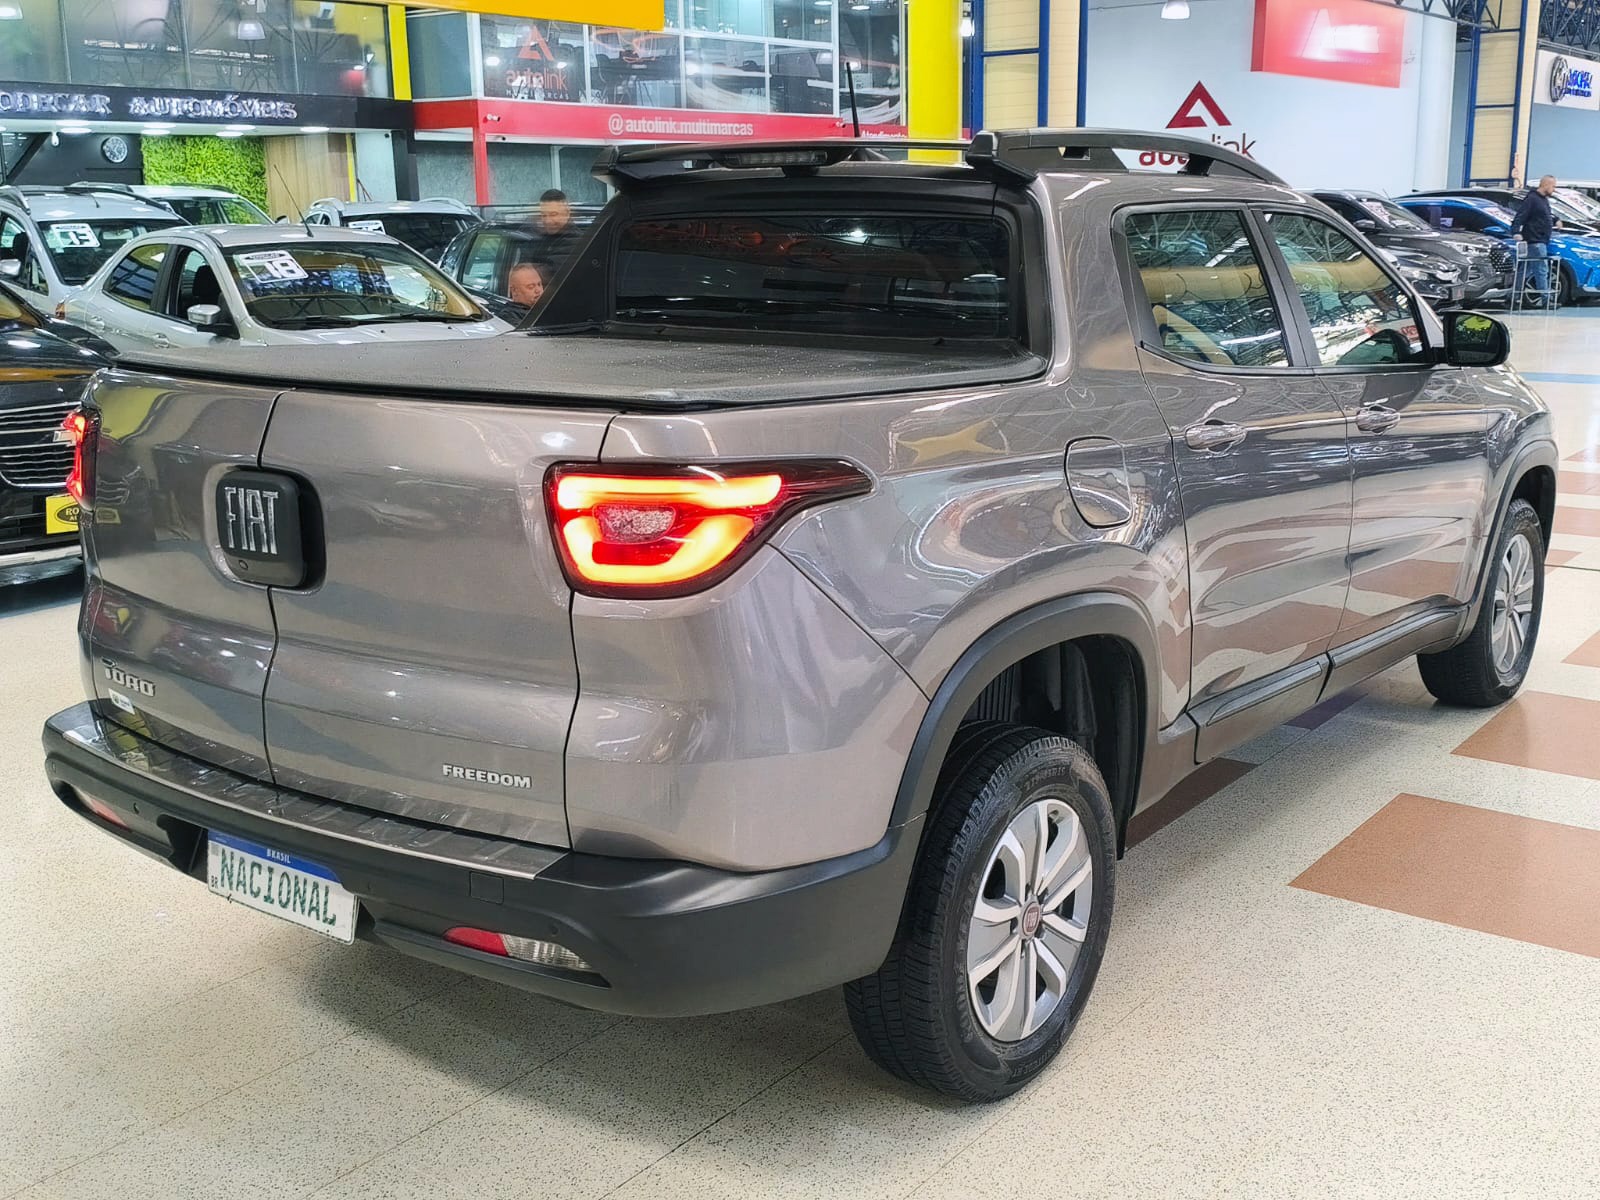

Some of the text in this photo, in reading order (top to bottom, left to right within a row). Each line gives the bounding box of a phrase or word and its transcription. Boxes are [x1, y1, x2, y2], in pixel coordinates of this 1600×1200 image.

[128, 94, 298, 119] AUTOMÓVEIS
[608, 113, 754, 136] @autolink.multimarcas
[224, 486, 279, 555] FIAT
[102, 658, 156, 697] TORO
[442, 764, 533, 789] FREEDOM
[266, 848, 291, 864] BRASIL
[220, 848, 337, 926] NACIONAL
